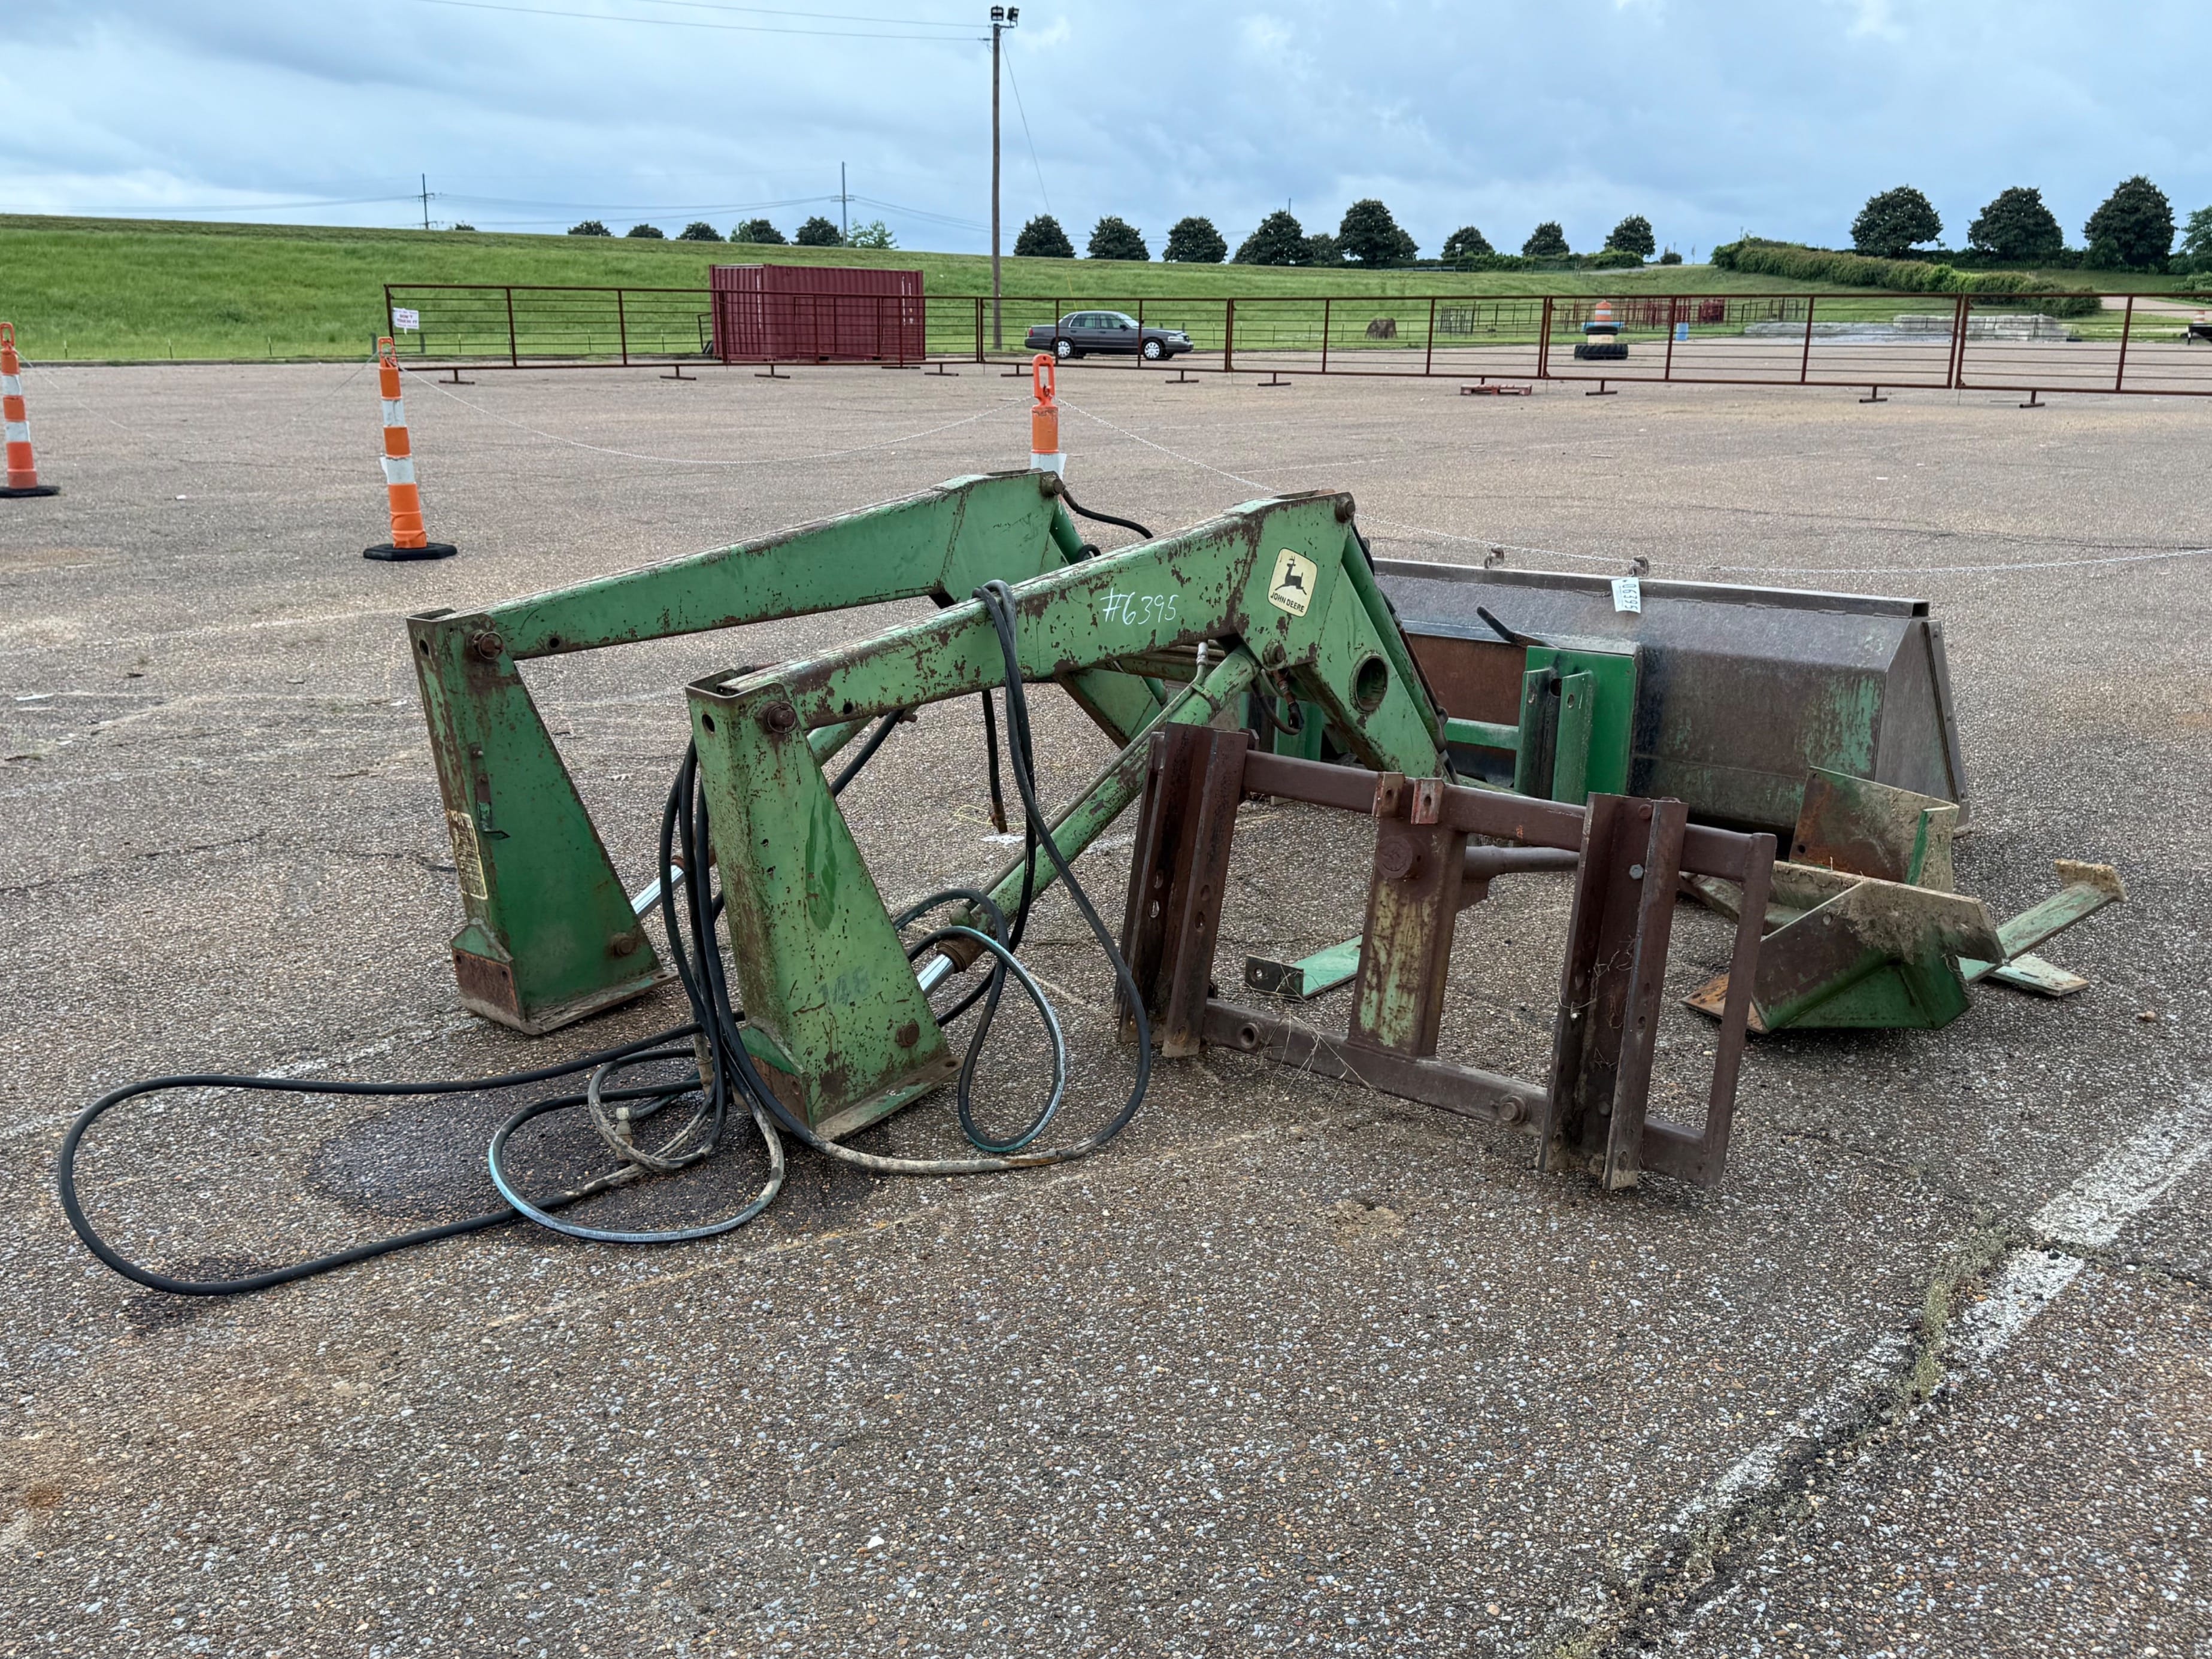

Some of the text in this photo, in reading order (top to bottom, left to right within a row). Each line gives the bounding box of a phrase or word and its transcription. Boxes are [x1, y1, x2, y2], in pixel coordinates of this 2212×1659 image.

[1099, 587, 1179, 625] #6395
[1270, 592, 1305, 612] JOHN DEERE
[1622, 584, 1638, 610] 06395
